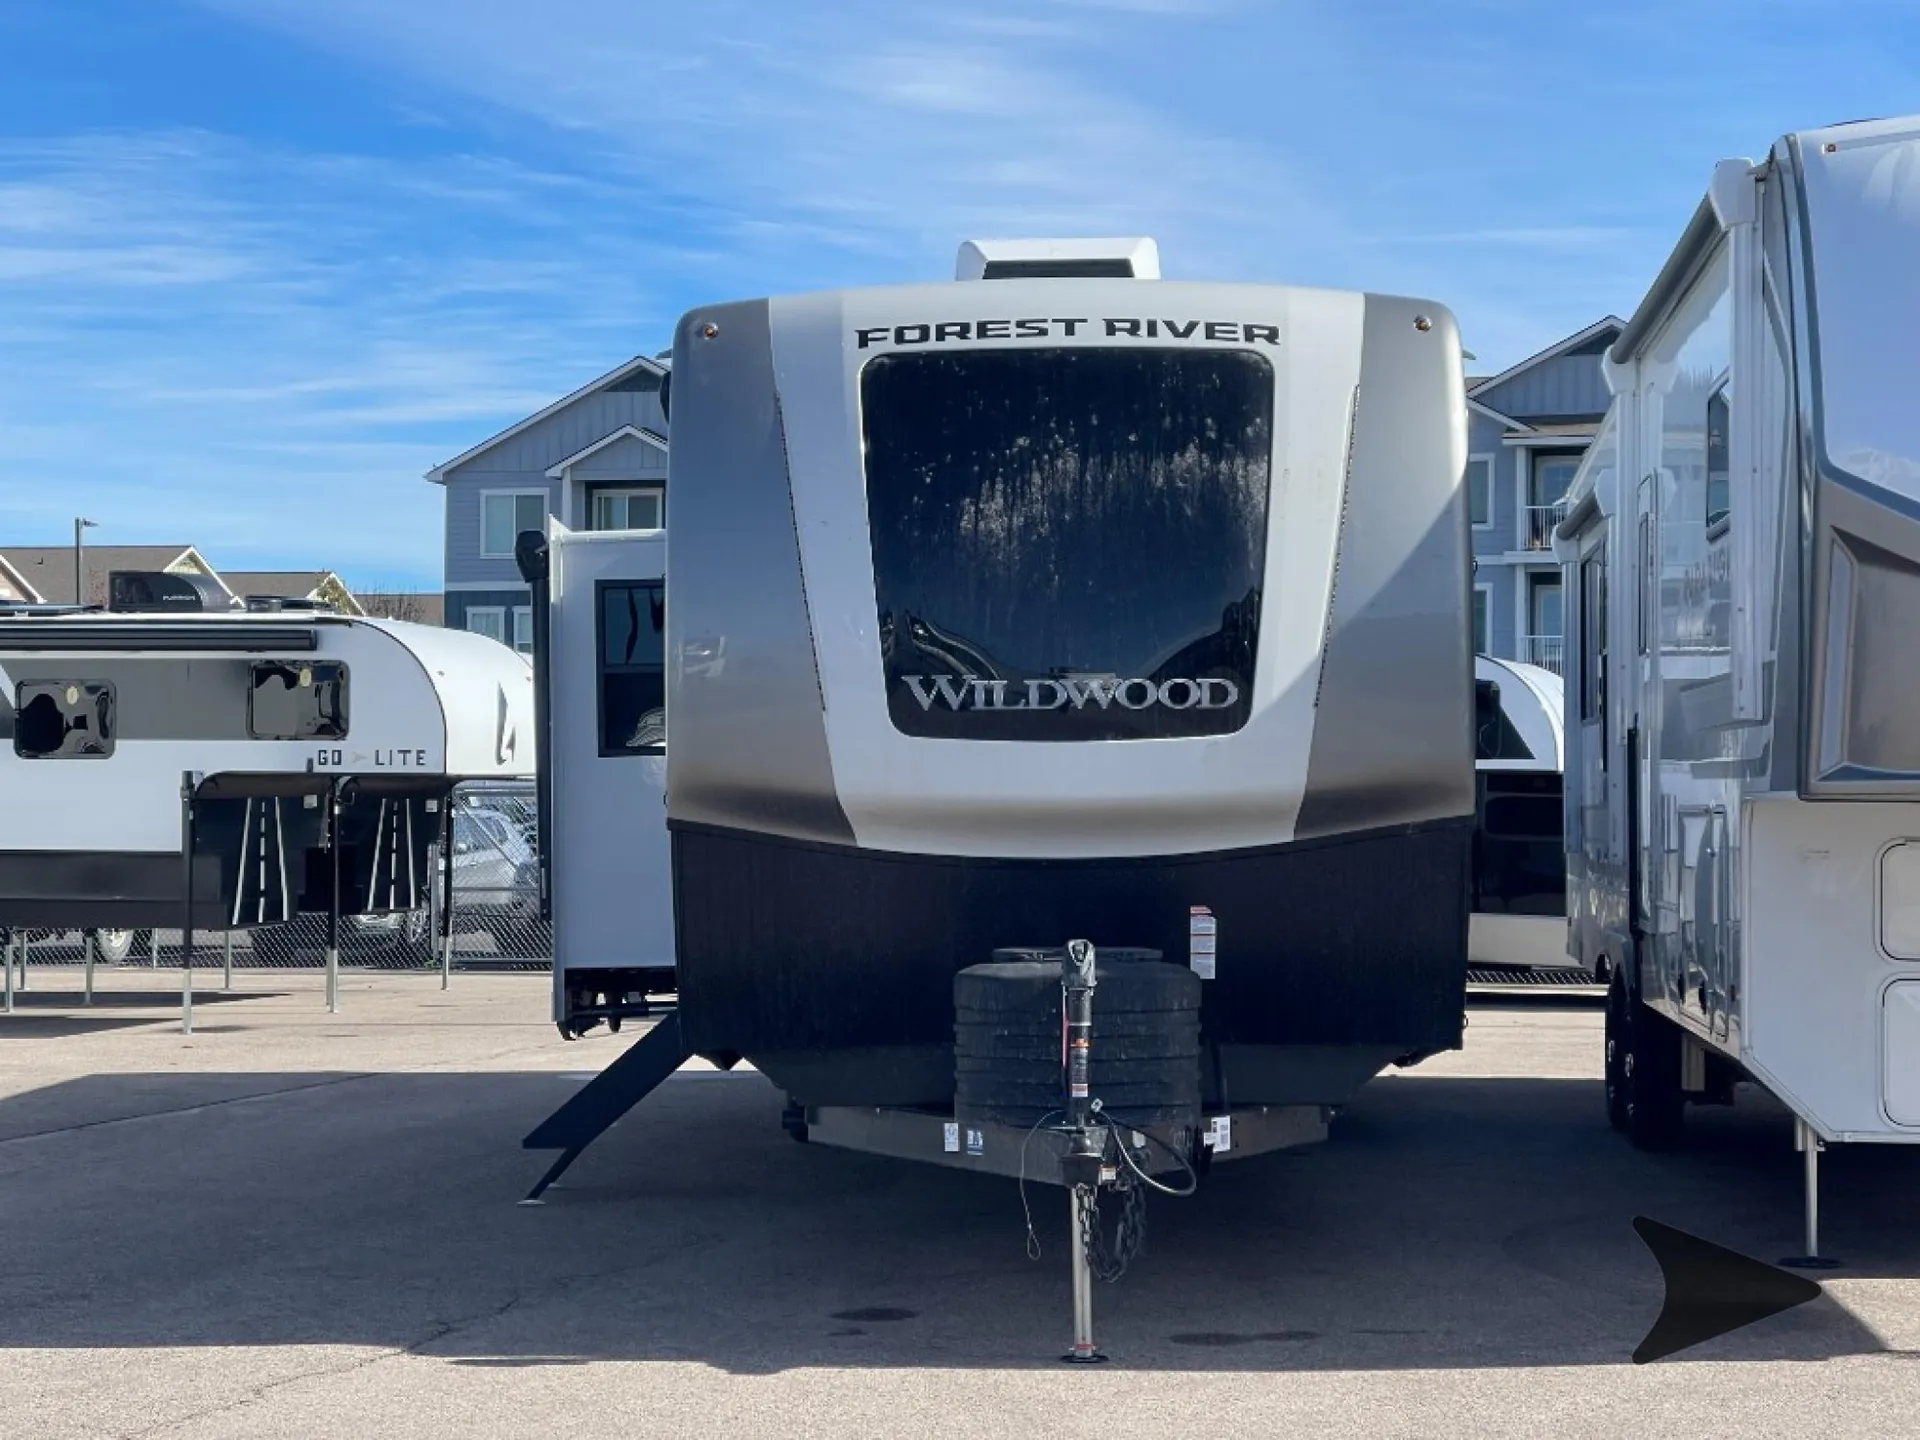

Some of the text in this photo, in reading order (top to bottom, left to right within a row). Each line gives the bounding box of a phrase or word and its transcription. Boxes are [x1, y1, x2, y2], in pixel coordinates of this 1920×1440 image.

[855, 318, 1281, 349] FOREST RIVER
[901, 674, 1239, 712] WILDWOOD
[318, 749, 426, 766] GO LITE
